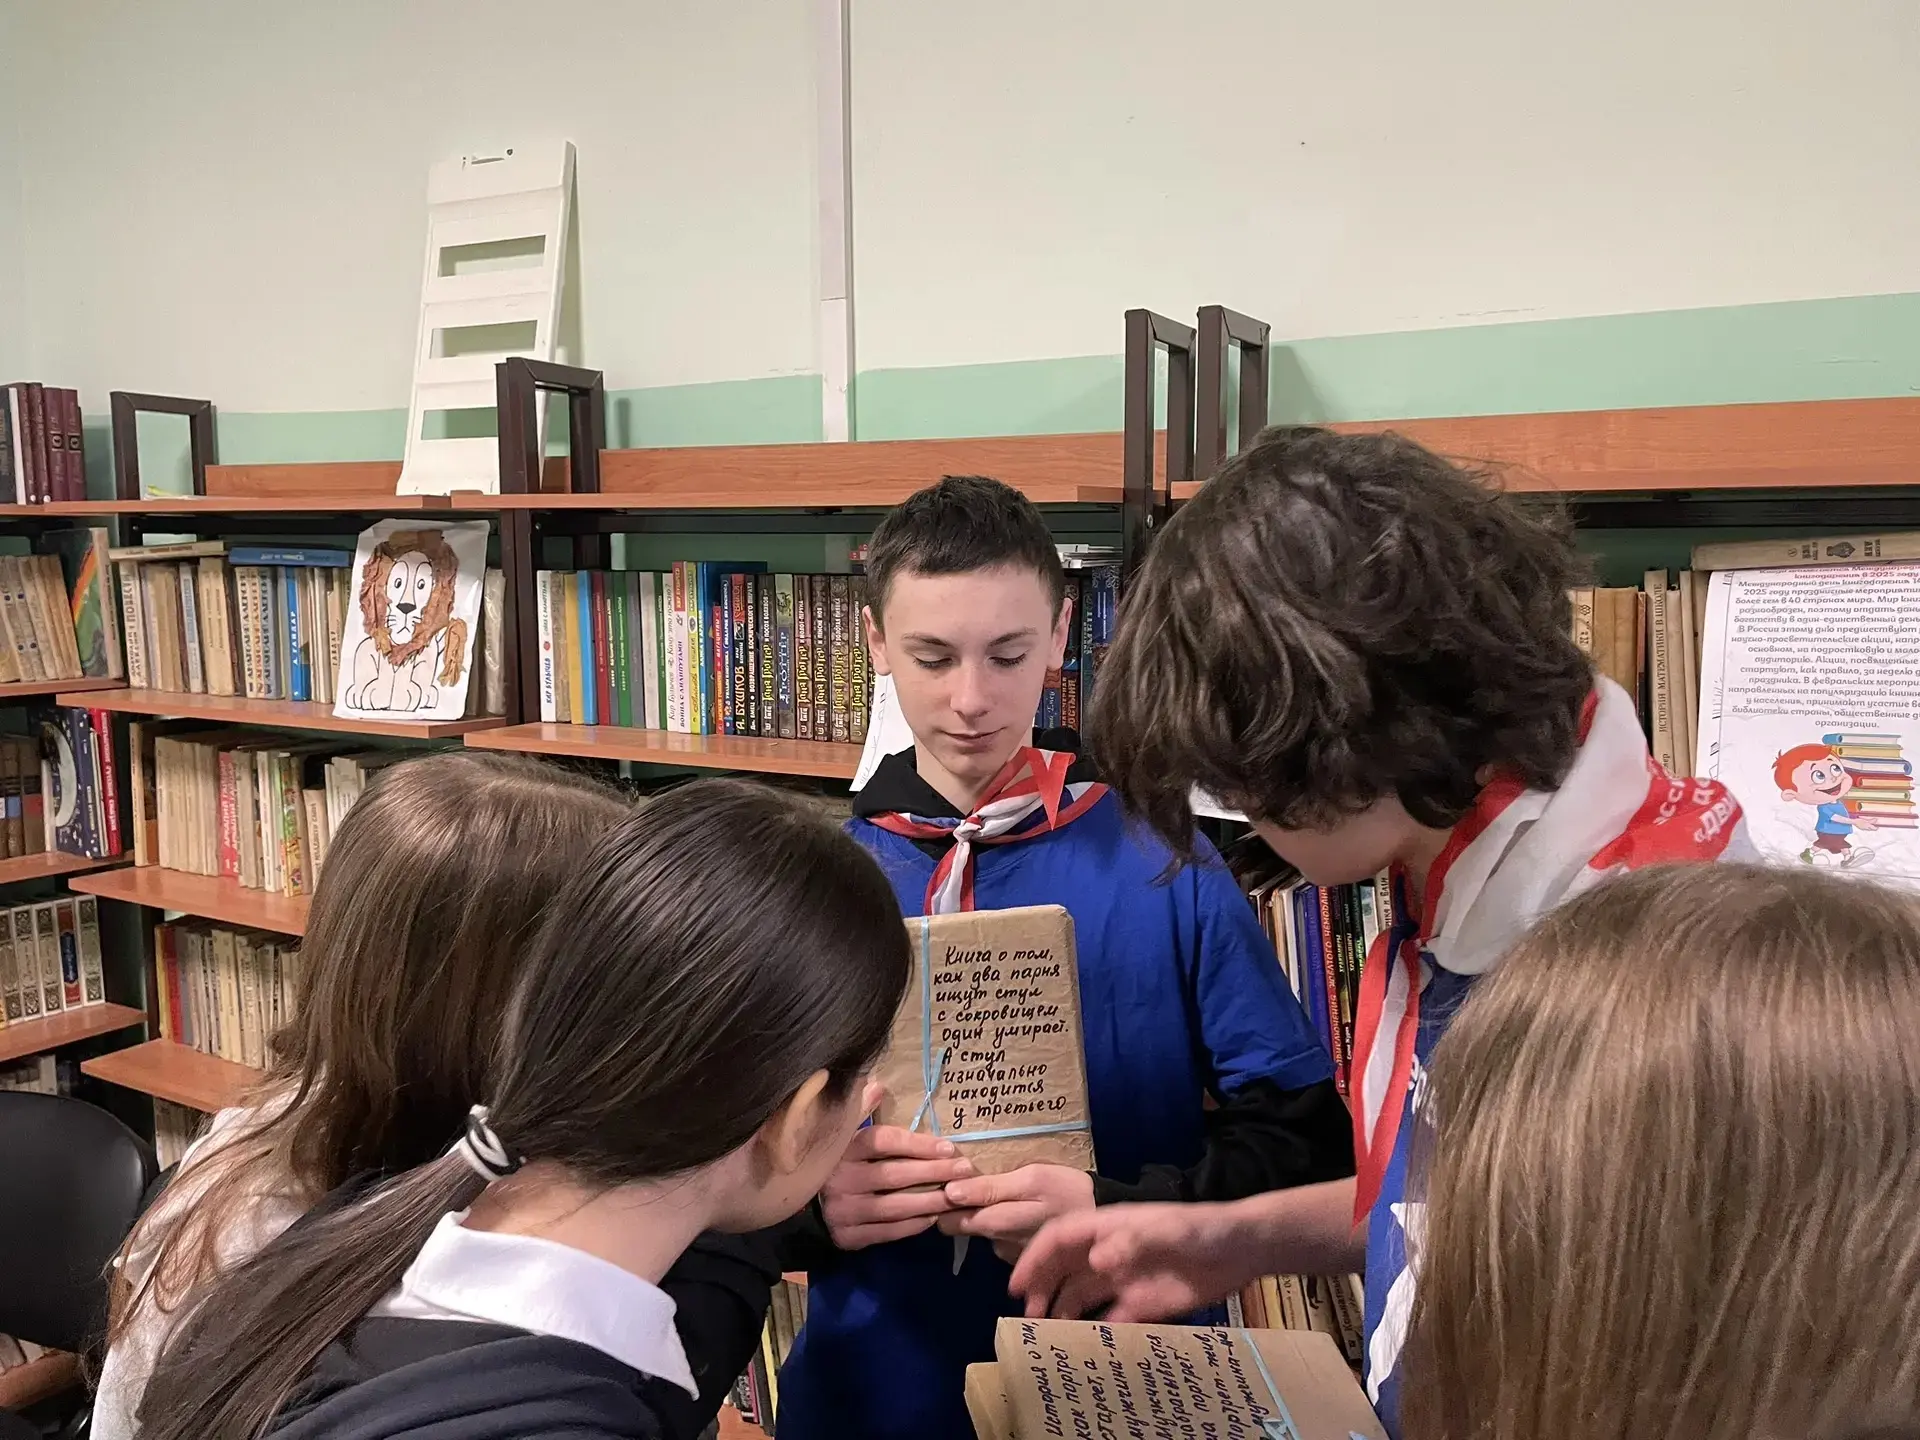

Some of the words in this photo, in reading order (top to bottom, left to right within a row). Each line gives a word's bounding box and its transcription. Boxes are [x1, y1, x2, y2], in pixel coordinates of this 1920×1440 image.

[1652, 584, 1662, 618] ШКОЛЕ
[1738, 606, 1806, 614] разнообразен,
[1877, 596, 1899, 604] Мир
[1734, 616, 1788, 624] богатству
[1796, 616, 1896, 624] один-единственный
[1815, 626, 1834, 634] дню
[1836, 625, 1917, 634] предшествуют
[1732, 635, 1860, 644] научно-просветительские
[1861, 636, 1894, 644] акции,
[1748, 646, 1795, 654] основном,
[1810, 646, 1885, 655] подростковую
[762, 644, 774, 679] Гроттер
[796, 646, 810, 680] Гроттер
[814, 647, 828, 682] Гроттер
[831, 649, 846, 686] Гроттер
[850, 647, 864, 684] Гроттер
[1656, 630, 1665, 690] МАТЕМАТИКИ
[1740, 666, 1798, 674] стартуют,
[1800, 666, 1817, 674] как
[1819, 666, 1862, 675] правило,
[1876, 667, 1913, 676] неделю
[1754, 656, 1813, 664] аудиторию.
[1816, 656, 1848, 664] Акции,
[1850, 656, 1919, 664] посвященные
[734, 666, 745, 716] БУШКОВ
[762, 680, 774, 702] Таня
[1728, 686, 1795, 694] направленных
[1810, 688, 1887, 697] популяризацию
[1748, 676, 1801, 684] праздника.
[1812, 676, 1874, 686] февральских
[798, 682, 810, 704] Таня
[814, 683, 828, 708] Таня
[832, 688, 846, 710] Таня
[851, 684, 865, 708] Таня
[1806, 698, 1865, 706] принимают
[1868, 700, 1910, 708] участие
[1658, 693, 1668, 732] ИСТОРИЯ
[1732, 706, 1788, 714] библиотеки
[1790, 708, 1832, 716] страны,
[1834, 708, 1910, 718] общественные
[736, 718, 744, 730] А.
[1814, 720, 1880, 728] организации.
[944, 946, 990, 967] Книга
[998, 951, 1008, 962] о
[1013, 948, 1053, 964] том,
[1324, 941, 1336, 988] ЖЕЛТОГО
[934, 970, 963, 986] как
[970, 966, 1000, 989] два
[1010, 964, 1060, 984] парня
[935, 988, 988, 1010] ищут
[996, 987, 1042, 1010] стул
[938, 1011, 946, 1021] с
[956, 1004, 1060, 1026] сокровищем
[942, 1026, 984, 1048] один
[993, 1020, 1069, 1048] умирает.
[942, 1046, 952, 1064] А
[960, 1049, 1006, 1070] стул
[944, 1064, 1048, 1085] изначально
[949, 1079, 1044, 1104] находится
[953, 1108, 966, 1129] у
[976, 1096, 1066, 1122] третьего
[1022, 1322, 1040, 1346] том,
[1028, 1350, 1042, 1360] о
[1084, 1358, 1098, 1370] а
[1050, 1345, 1082, 1404] портрет
[1166, 1346, 1212, 1412] портрет!
[1031, 1366, 1063, 1437] История
